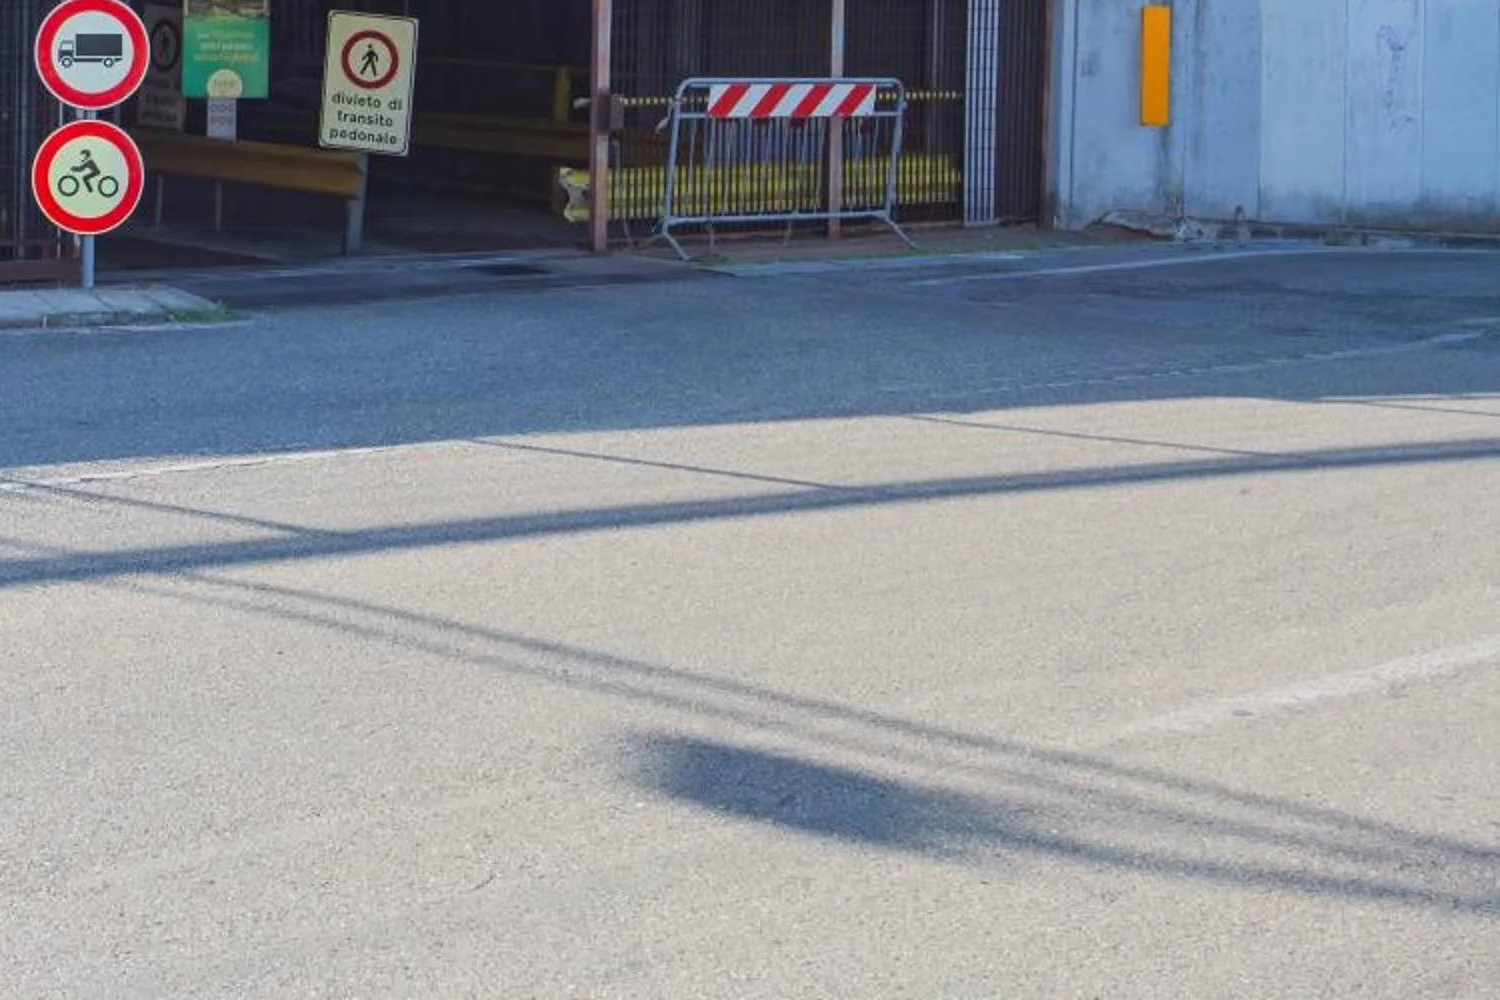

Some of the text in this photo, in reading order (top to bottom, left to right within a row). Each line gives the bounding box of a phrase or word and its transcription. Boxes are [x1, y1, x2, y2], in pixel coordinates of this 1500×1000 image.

[331, 92, 403, 111] divieto di
[337, 110, 394, 127] transito
[329, 128, 398, 145] pedonale
